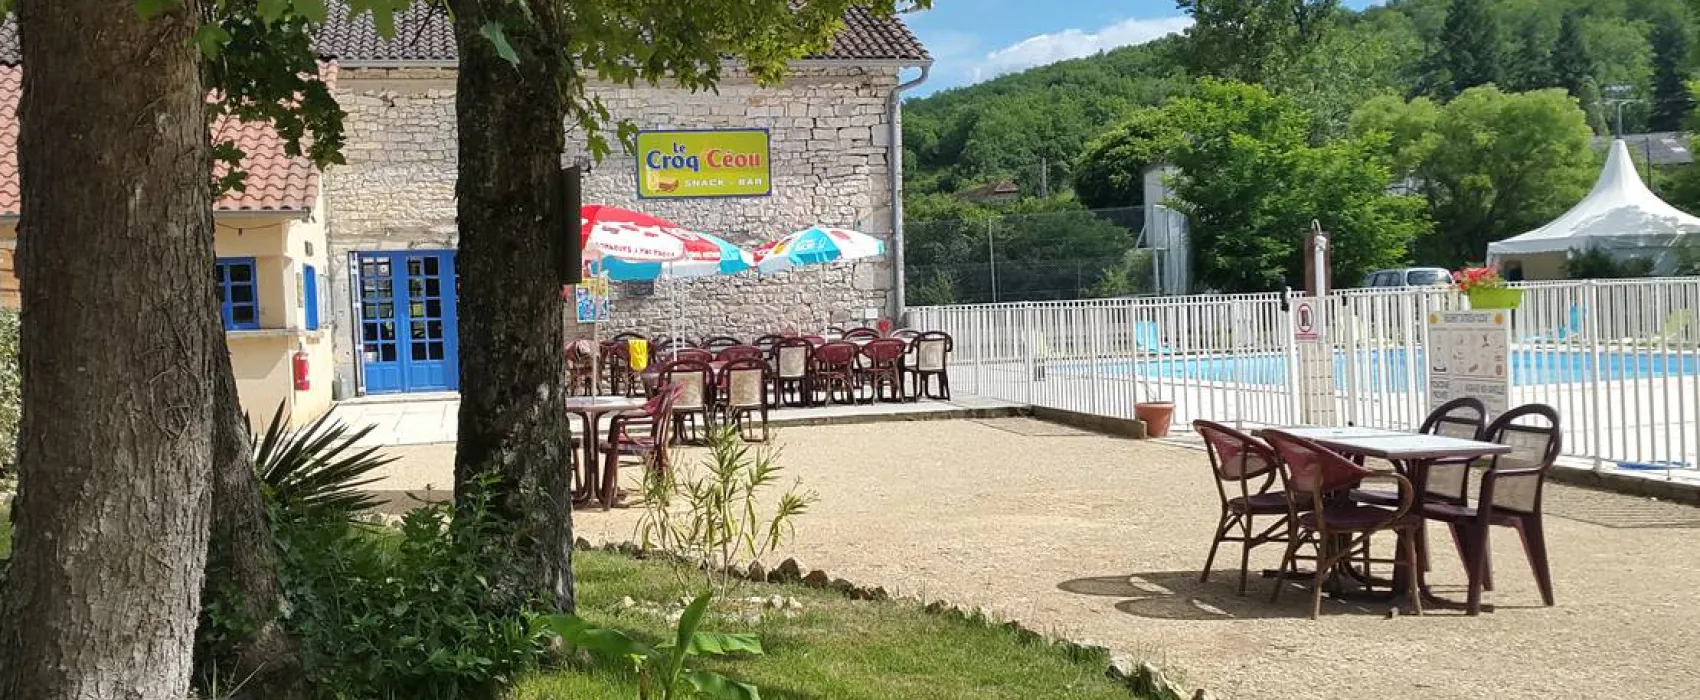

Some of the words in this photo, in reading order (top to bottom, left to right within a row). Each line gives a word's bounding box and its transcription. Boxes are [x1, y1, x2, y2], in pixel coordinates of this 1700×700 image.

[674, 141, 687, 153] Le
[647, 150, 699, 172] Croq
[685, 178, 725, 187] SNACK
[738, 178, 762, 186] BAR
